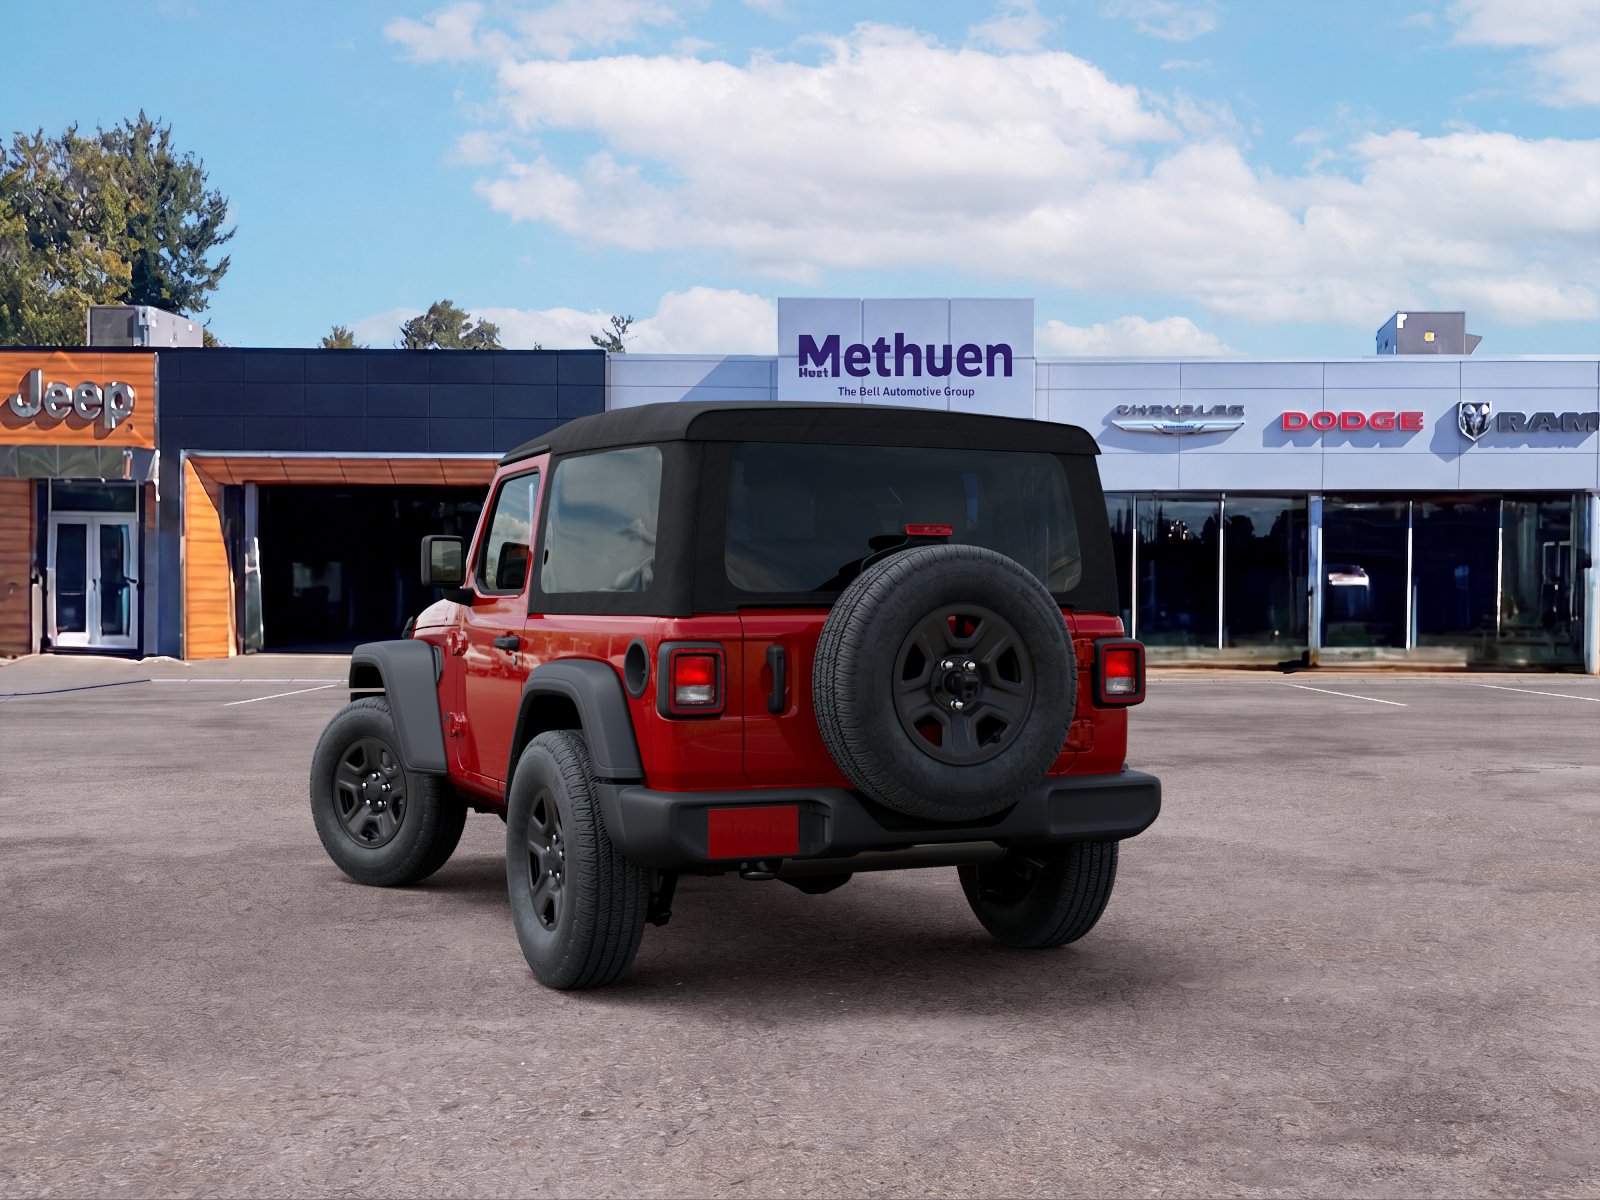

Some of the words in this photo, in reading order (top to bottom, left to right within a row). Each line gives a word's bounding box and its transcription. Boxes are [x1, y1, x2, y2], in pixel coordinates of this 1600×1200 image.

[798, 332, 1013, 378] Methuen
[9, 368, 136, 429] Jeep
[837, 386, 857, 397] The
[859, 386, 880, 397] Bell
[882, 386, 942, 397] Automotive
[943, 386, 975, 399] Group
[1282, 411, 1424, 431] DODGE
[1497, 411, 1600, 432] RAM
